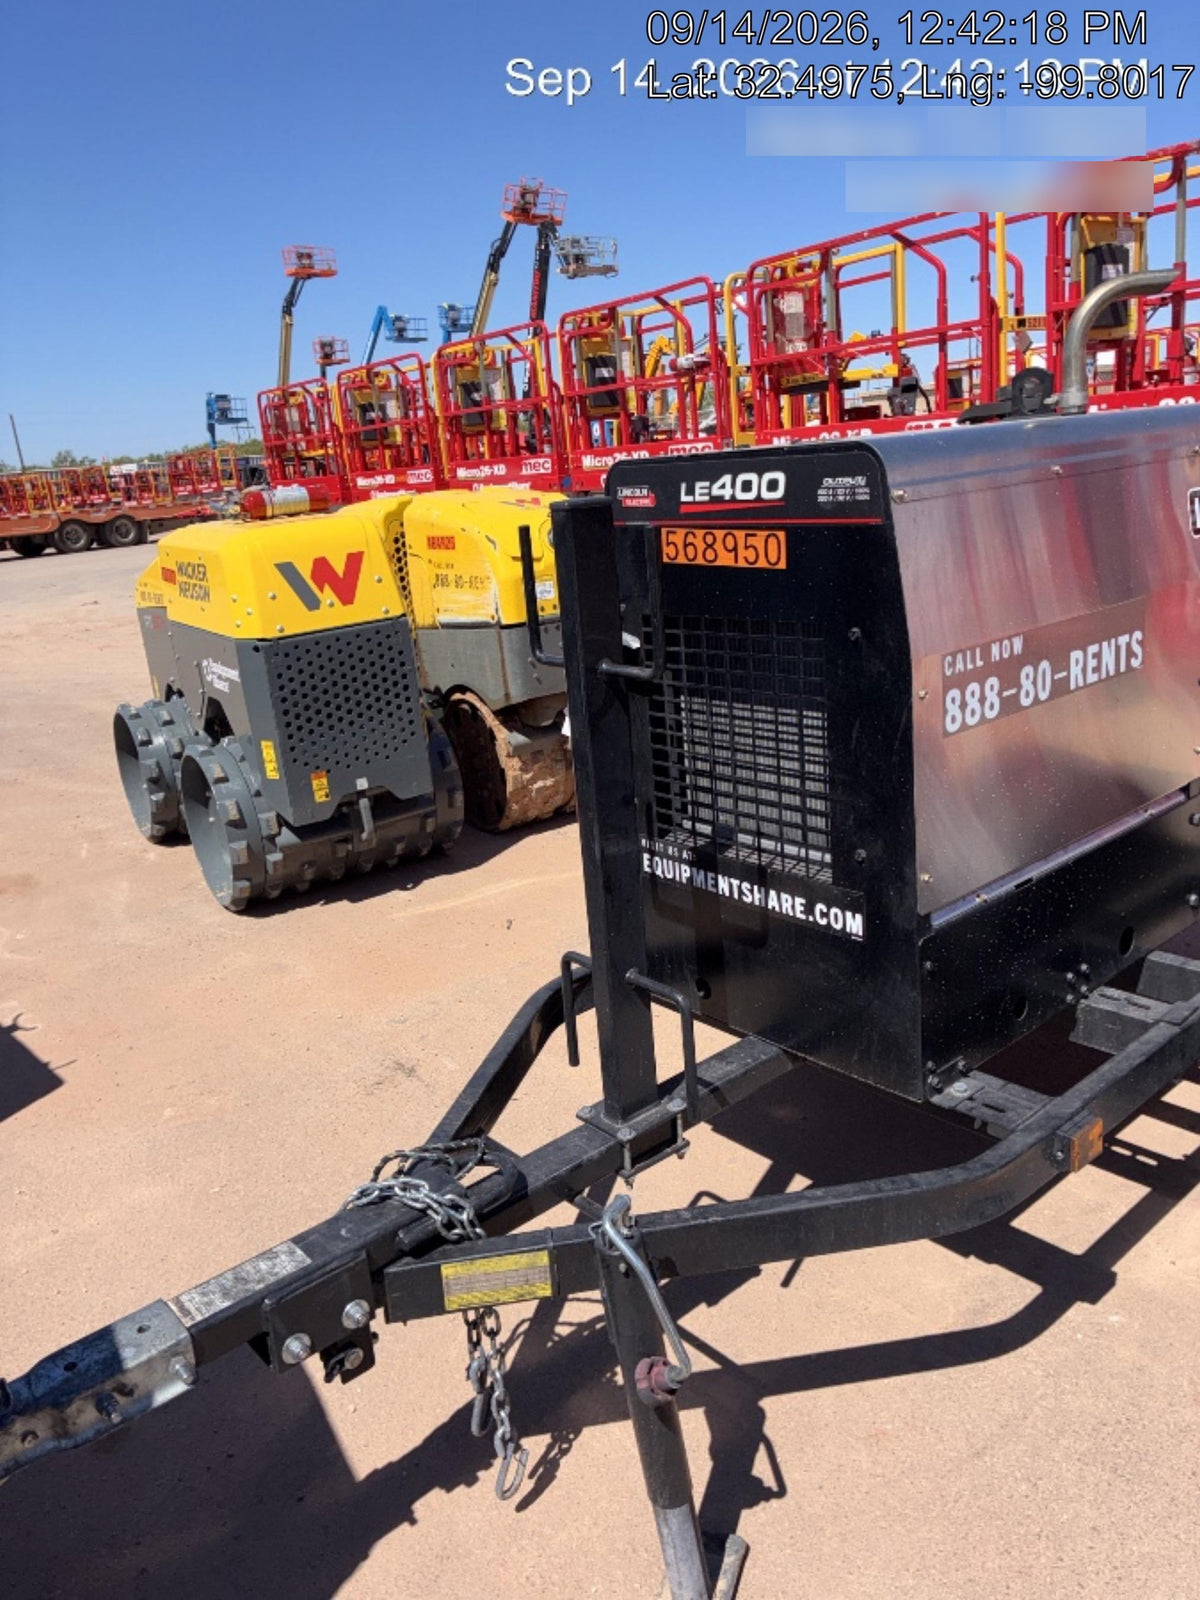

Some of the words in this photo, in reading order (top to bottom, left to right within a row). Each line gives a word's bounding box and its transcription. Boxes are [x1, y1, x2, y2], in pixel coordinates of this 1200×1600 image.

[680, 471, 786, 502] LE400
[665, 530, 782, 566] 568950
[175, 560, 209, 583] WACKER
[943, 647, 985, 677] CALL
[991, 634, 1025, 663] NOW
[944, 629, 1144, 734] 888-80-RENTS
[642, 852, 863, 937] EQUIPMENTSHARE.COM
